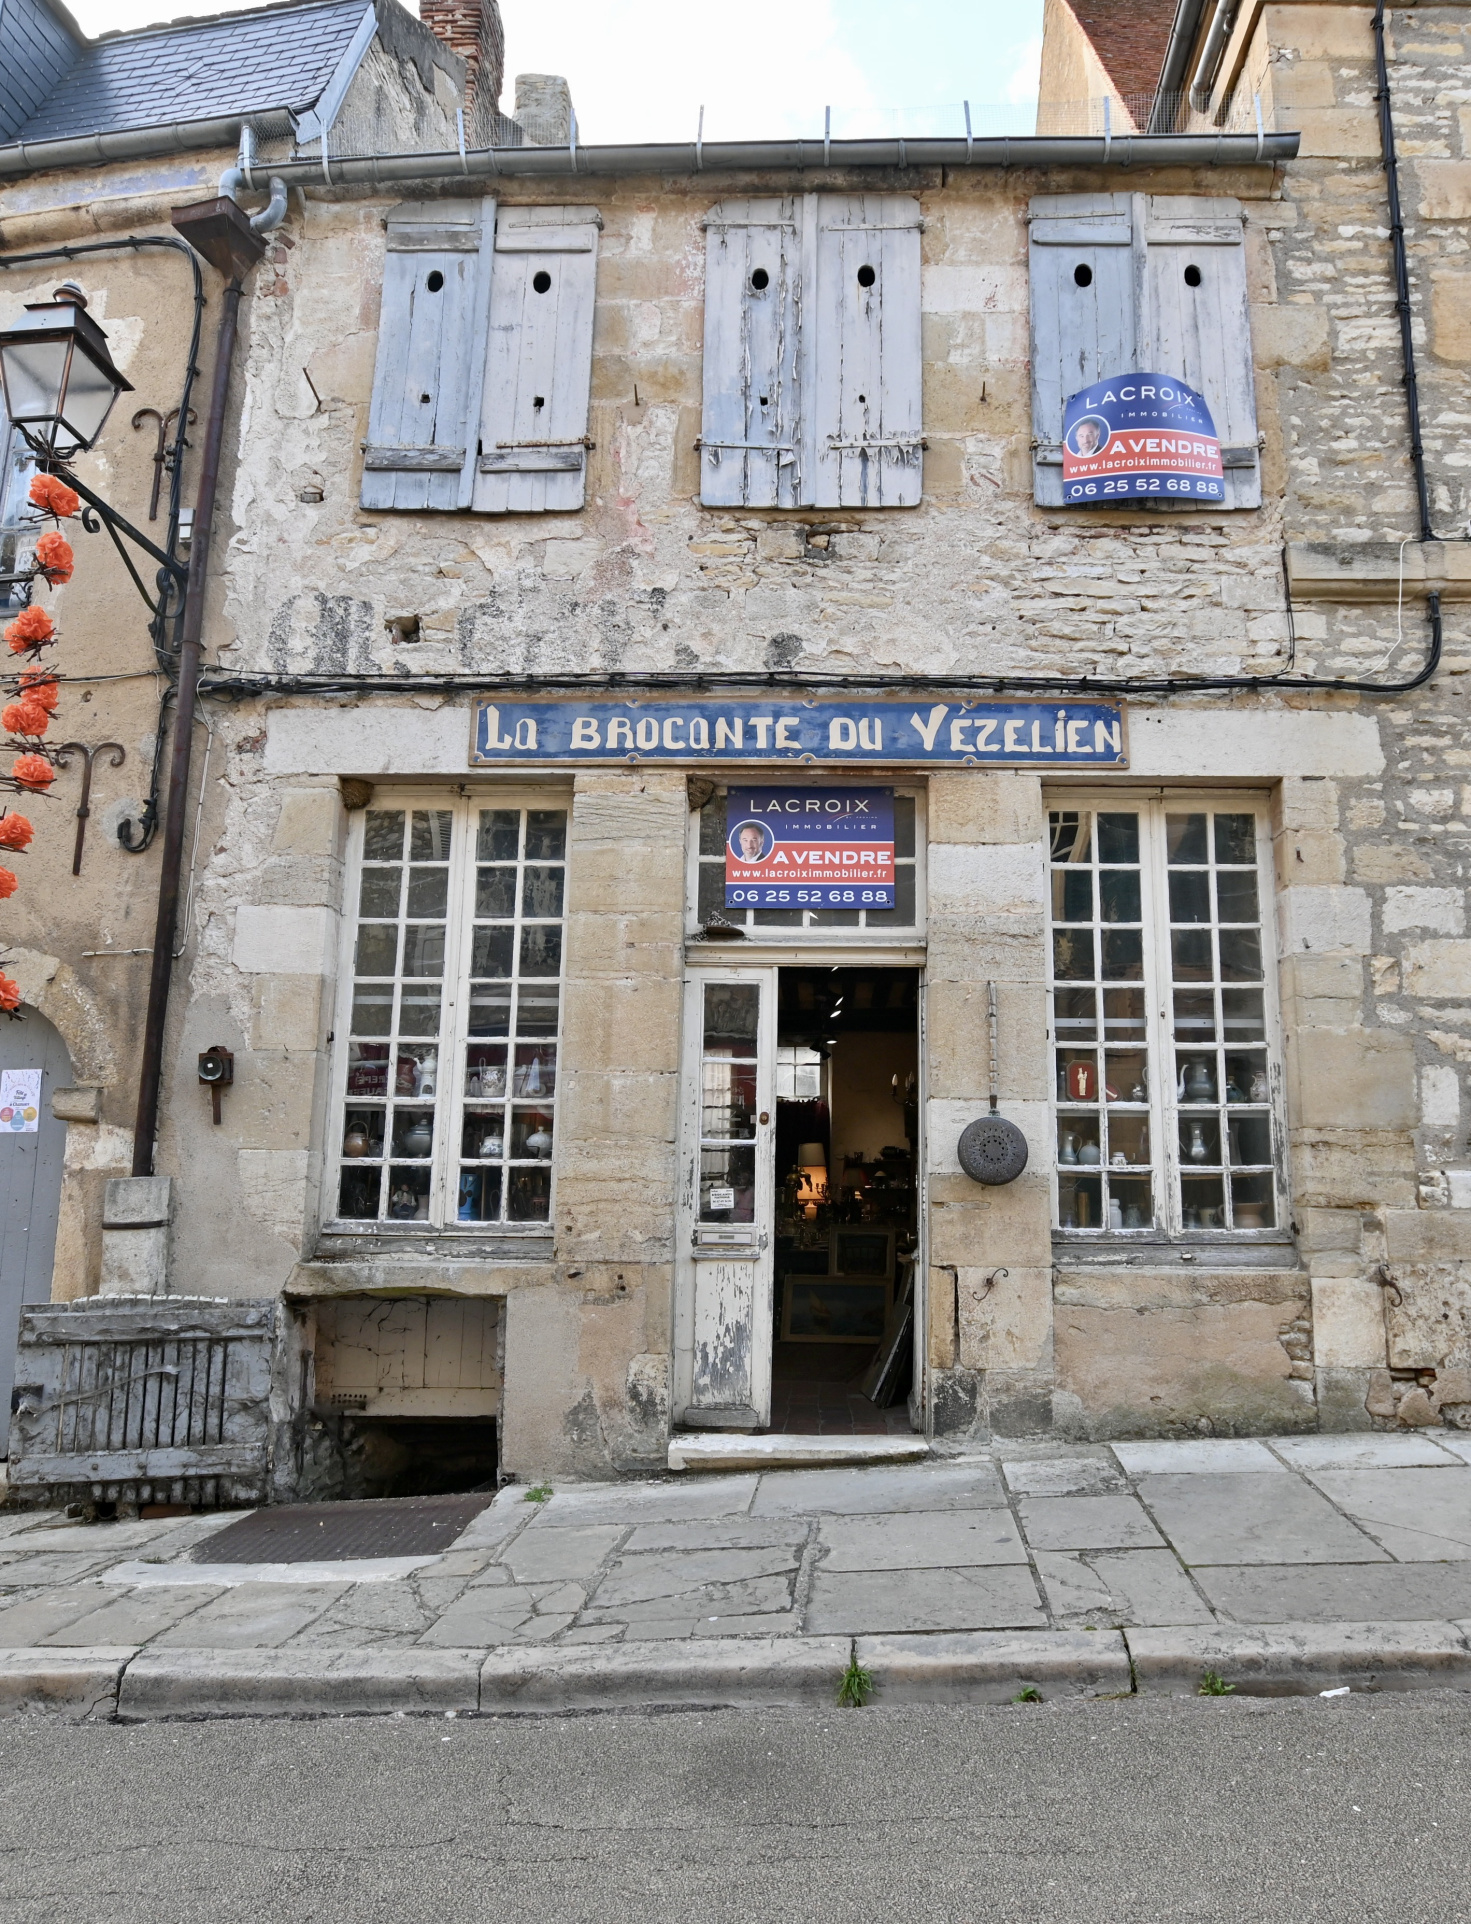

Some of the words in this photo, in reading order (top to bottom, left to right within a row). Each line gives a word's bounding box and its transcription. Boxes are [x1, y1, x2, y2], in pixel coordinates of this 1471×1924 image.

[1086, 385, 1195, 409] LACROIX
[1120, 411, 1203, 424] IMMOBILIER
[1109, 440, 1126, 455] A
[1129, 438, 1219, 459] VENDRE
[1069, 456, 1217, 474] www.lacroiximmobilier.fr
[1071, 483, 1097, 497] 06
[1103, 480, 1129, 494] 25
[1135, 479, 1160, 491] 52
[1166, 479, 1191, 492] 68
[1196, 481, 1219, 495] 88
[828, 717, 883, 751] DU
[750, 799, 869, 813] LACROIX
[772, 851, 790, 864] A
[792, 851, 892, 865] VENDRE
[732, 868, 887, 879] www.lacroiximmobilier.fr
[733, 890, 759, 902] 06
[765, 890, 790, 902] 25
[797, 890, 822, 902] 52
[828, 890, 855, 902] 68
[861, 890, 887, 902] 88
